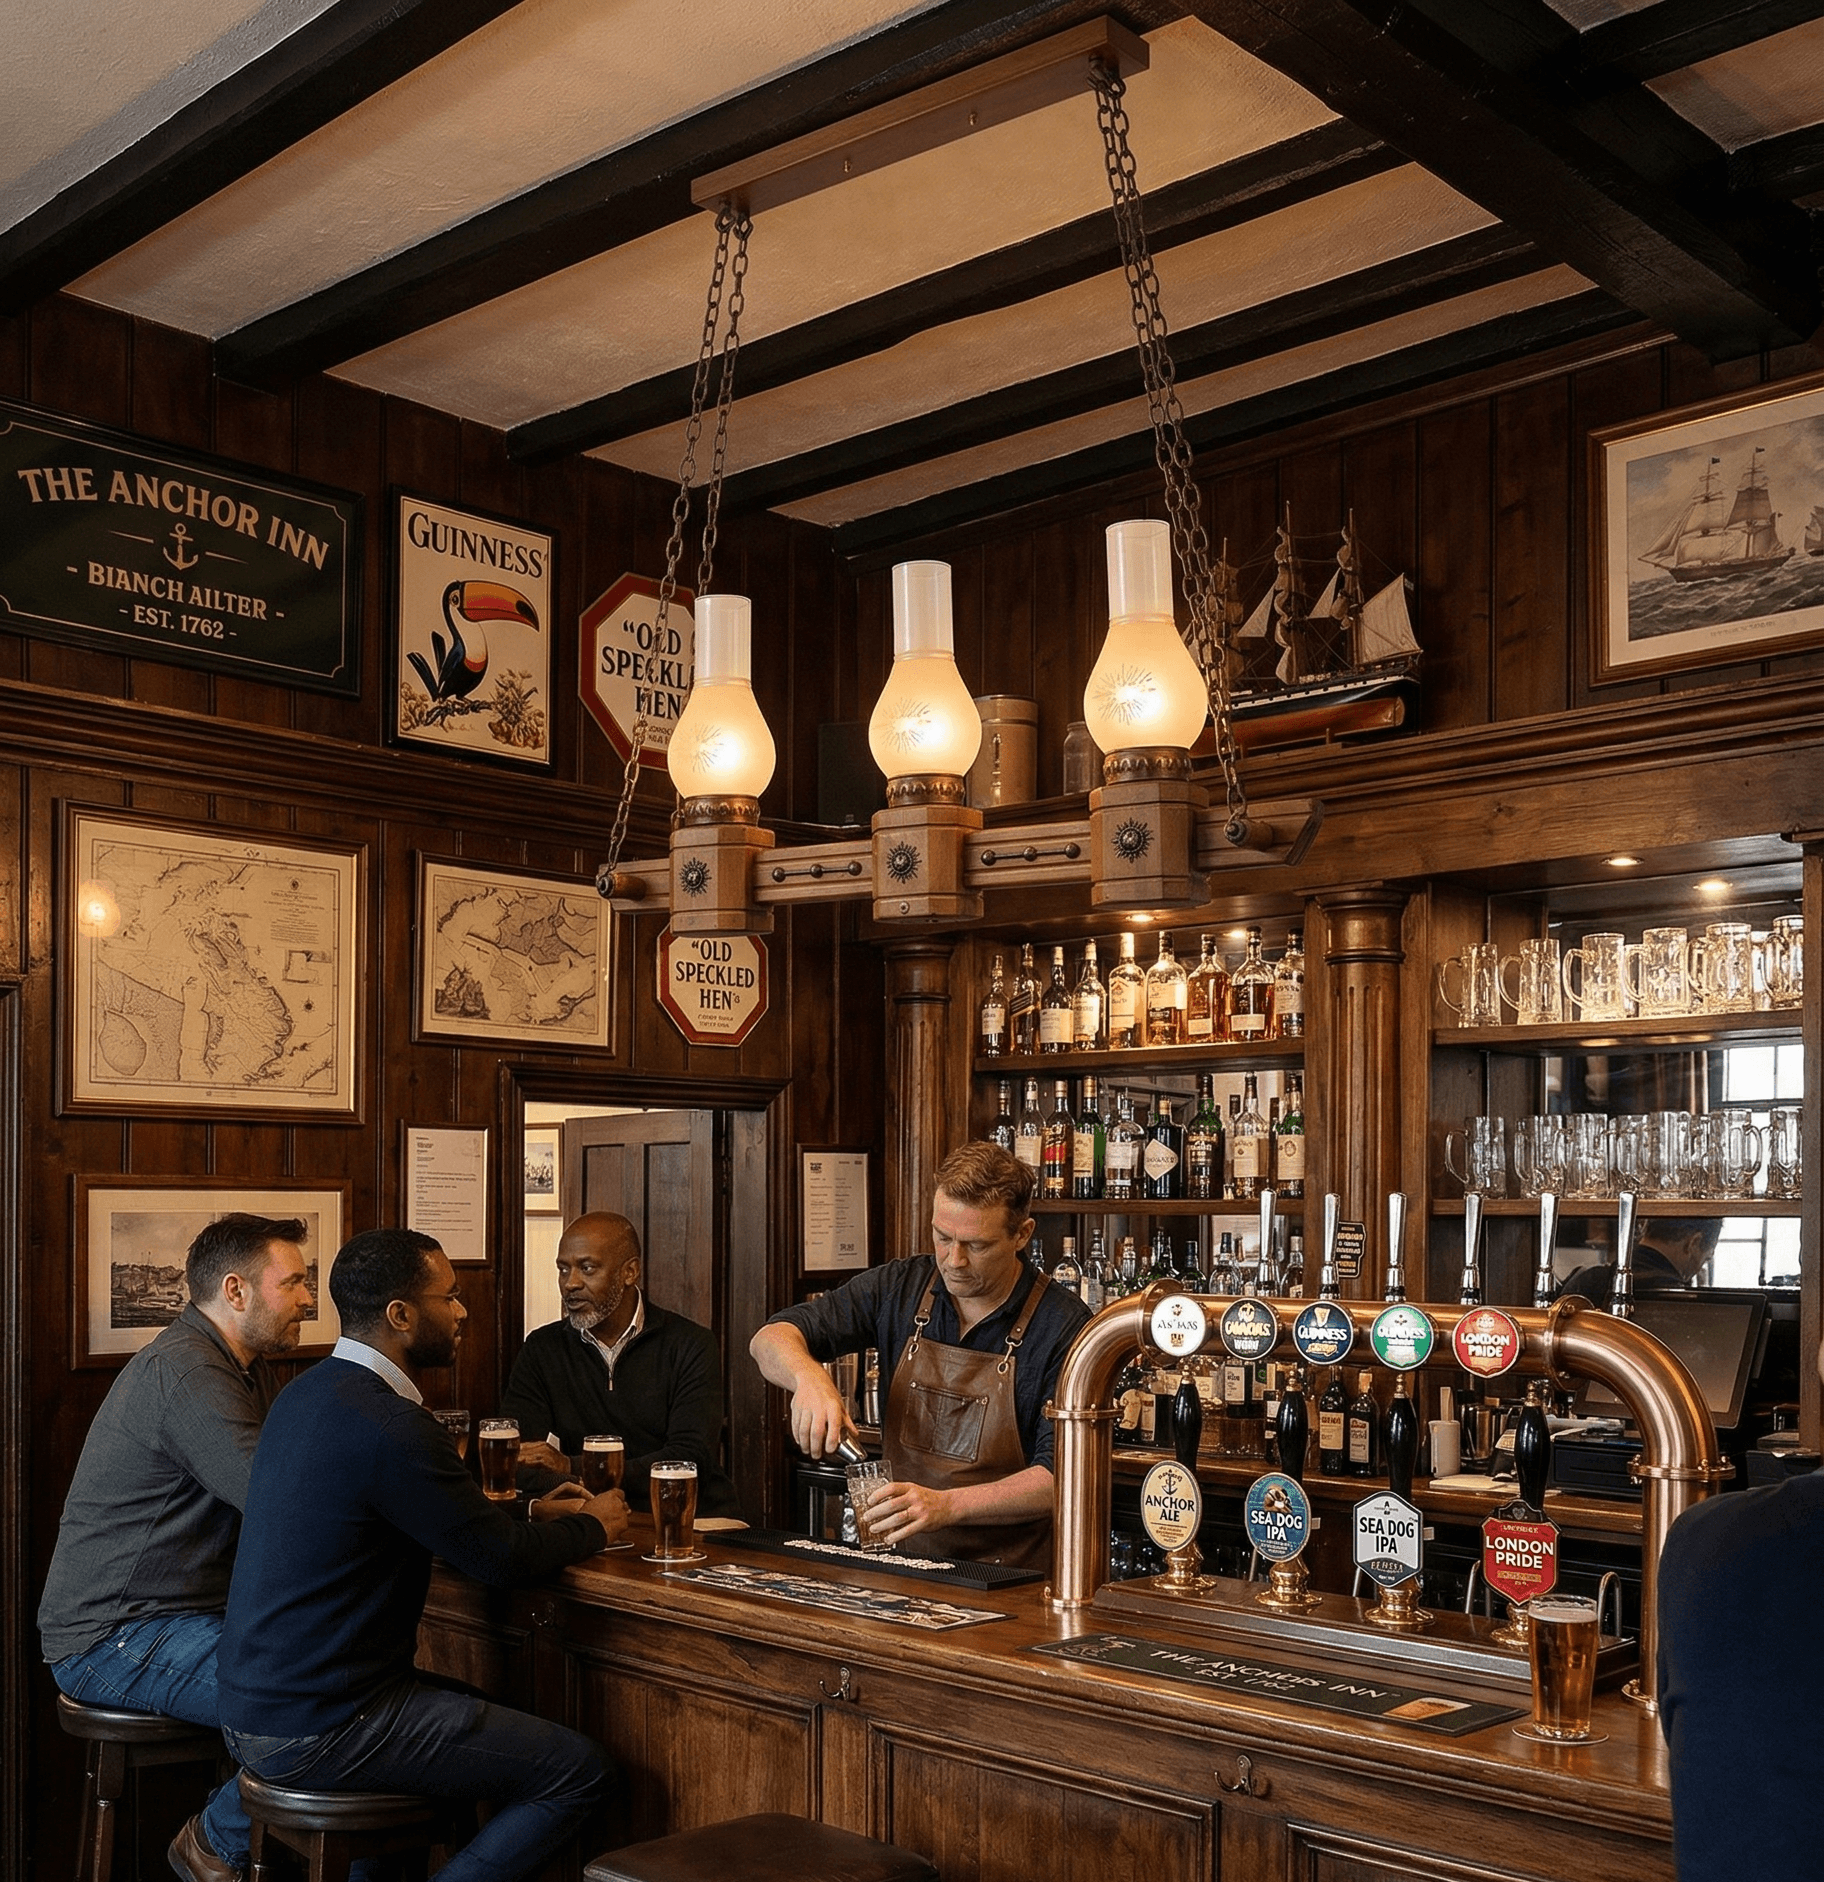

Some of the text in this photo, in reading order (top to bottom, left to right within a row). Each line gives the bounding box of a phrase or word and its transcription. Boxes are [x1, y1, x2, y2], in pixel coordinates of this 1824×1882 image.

[18, 468, 329, 571] THE ANCHOR INN
[88, 561, 267, 621] BIANCH AILTER
[133, 604, 225, 640] EST. 1762
[676, 961, 755, 988] SPECKLED
[1460, 1332, 1510, 1346] LONDON
[1468, 1344, 1503, 1358] PRIDE
[1145, 1494, 1195, 1512] ANCHOR
[1160, 1508, 1180, 1522] ALE
[1251, 1510, 1303, 1529] SEA DOG
[1267, 1525, 1287, 1541] IPA
[1359, 1516, 1414, 1538] SEA DOG
[1376, 1535, 1397, 1554] IPA
[1486, 1536, 1553, 1555] LONDON
[1496, 1551, 1542, 1569] PRIDE
[1328, 1683, 1387, 1698] INN
